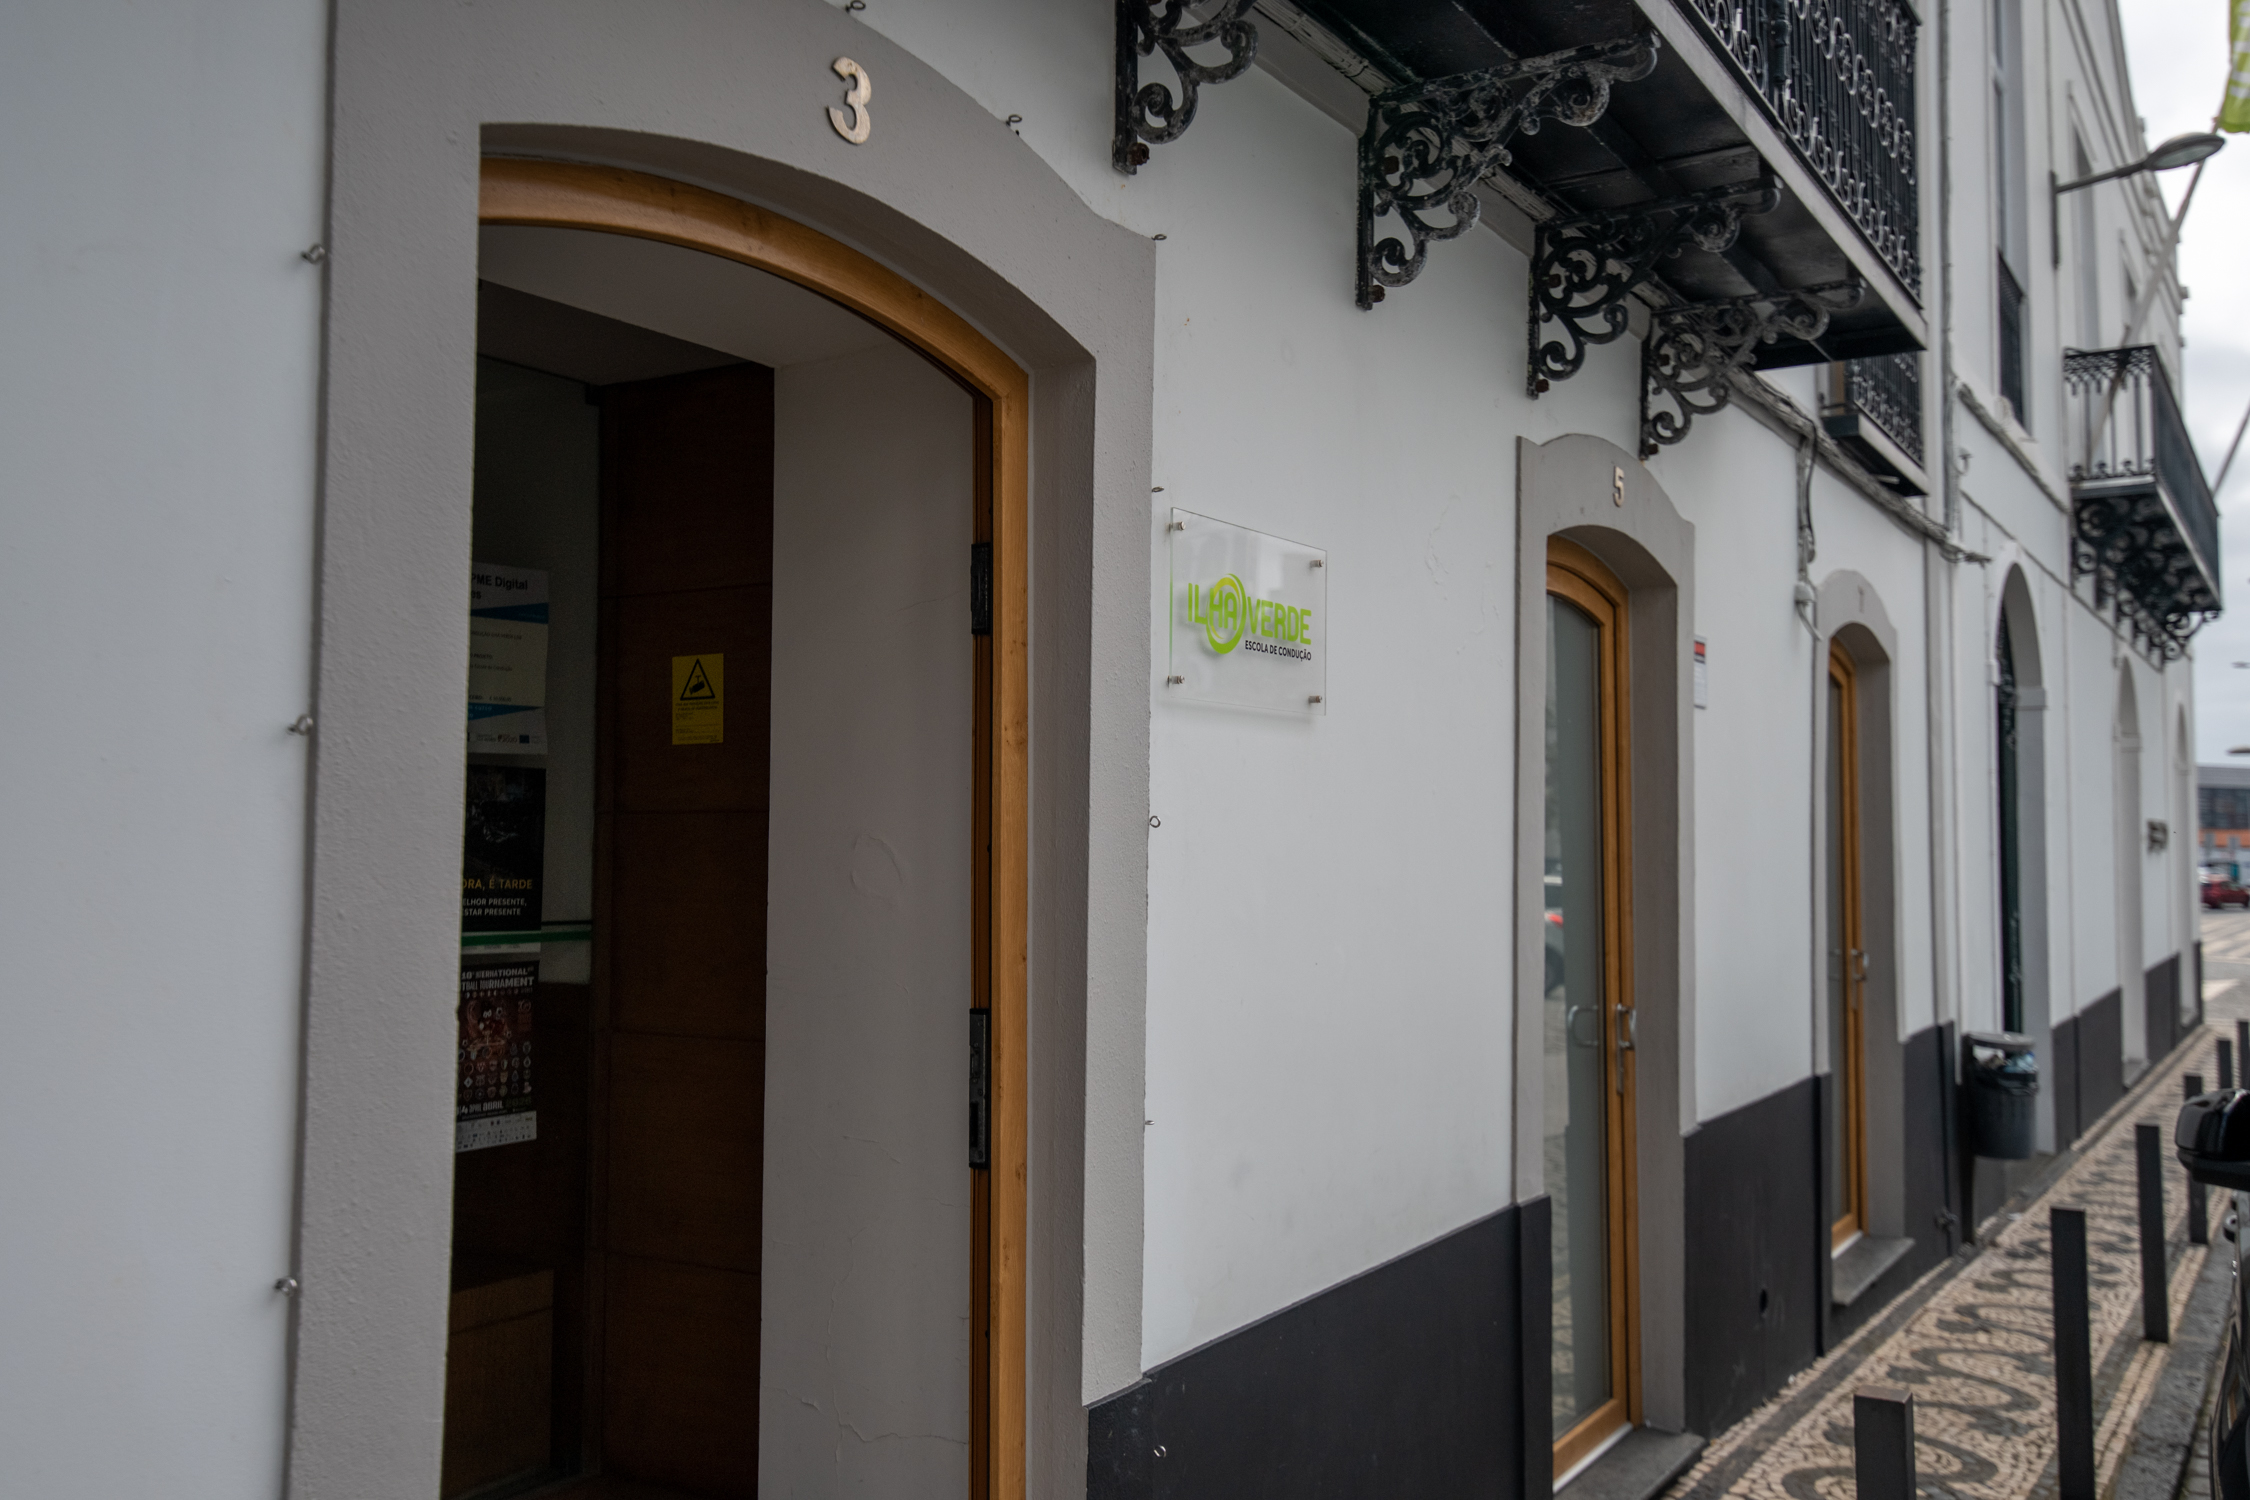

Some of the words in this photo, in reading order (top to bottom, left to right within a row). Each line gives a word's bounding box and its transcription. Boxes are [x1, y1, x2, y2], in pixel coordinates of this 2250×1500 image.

[827, 56, 871, 145] 3
[1613, 465, 1625, 508] 5
[495, 576, 528, 591] Digital
[1188, 582, 1238, 631] ILHA
[1247, 596, 1312, 645] VERDE
[1244, 640, 1268, 653] ESCOLA
[1269, 645, 1277, 655] DE
[1278, 647, 1312, 662] CONDUÇÃO
[489, 875, 495, 889] É
[499, 878, 533, 890] TARDE
[462, 897, 487, 906] ELHOR
[488, 897, 527, 907] PRESENTE,
[462, 907, 483, 916] STAR
[484, 907, 521, 916] PRESENTE
[475, 967, 528, 979] INTERNATIONAL
[462, 980, 478, 991] TBALL
[480, 976, 535, 990] TOURNAMENT
